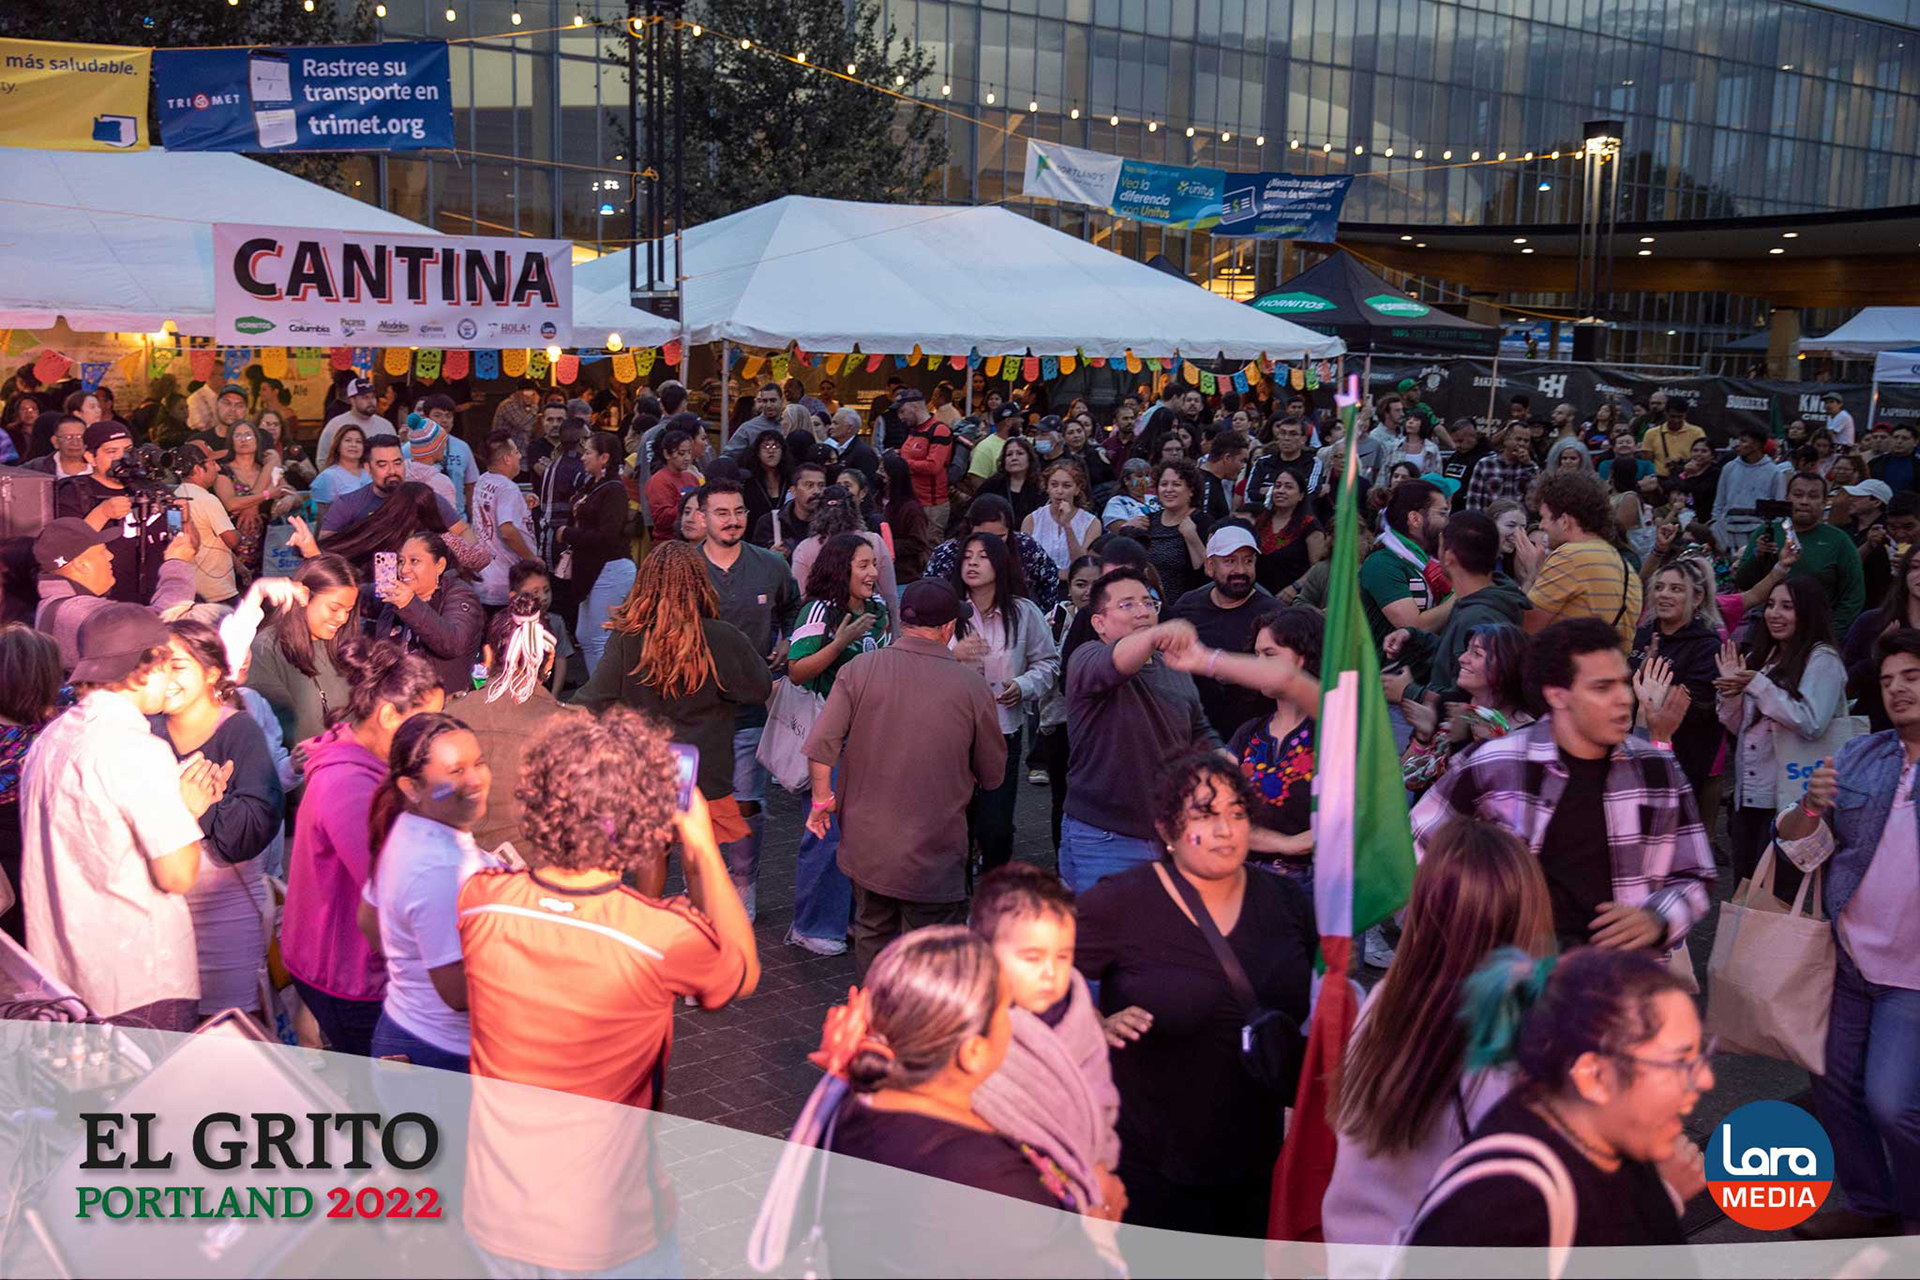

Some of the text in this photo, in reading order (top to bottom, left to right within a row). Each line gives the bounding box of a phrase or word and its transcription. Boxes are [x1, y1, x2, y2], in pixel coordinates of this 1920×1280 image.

[6, 54, 138, 76] más saludable.
[303, 59, 407, 77] Rastree su
[303, 83, 439, 105] transporte en
[308, 114, 426, 139] trimet.org
[1119, 190, 1170, 206] diferencia
[234, 238, 559, 307] CANTINA
[1258, 299, 1326, 311] HORNITOS
[289, 324, 330, 334] Columbia
